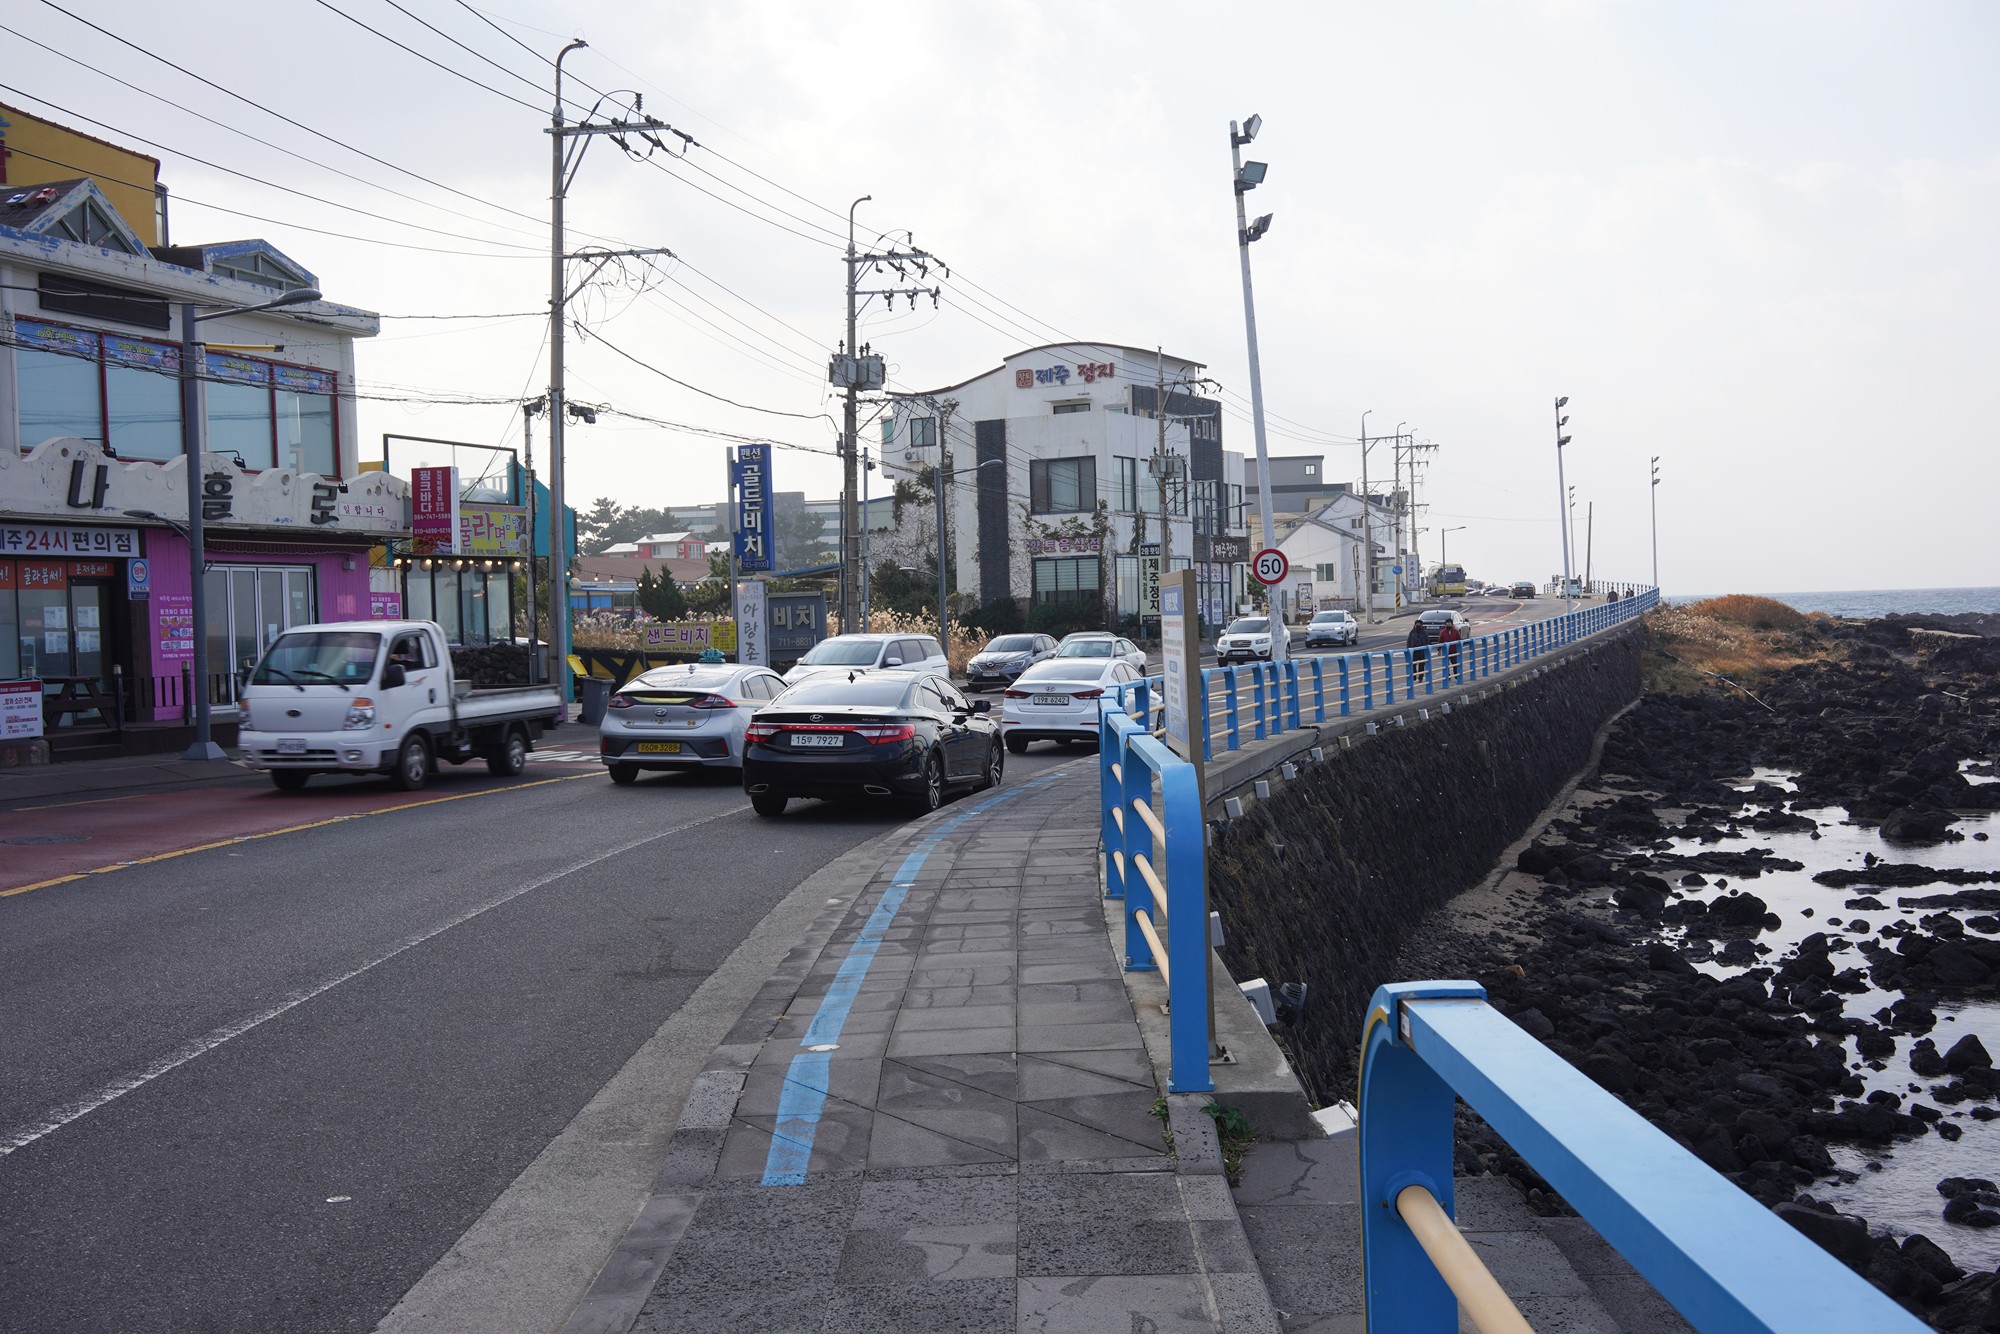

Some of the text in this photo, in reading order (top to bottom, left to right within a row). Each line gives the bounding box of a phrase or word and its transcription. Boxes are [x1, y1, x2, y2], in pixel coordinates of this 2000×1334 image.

[1035, 365, 1070, 385] 제주
[1077, 363, 1115, 384] 정지
[420, 470, 432, 512] 핑크바다
[741, 463, 764, 557] 골든비치
[1260, 558, 1281, 575] 50
[1148, 558, 1160, 613] 제주정지
[773, 604, 816, 631] 비치
[647, 627, 709, 645] 샌드비치
[816, 735, 840, 746] 7927
